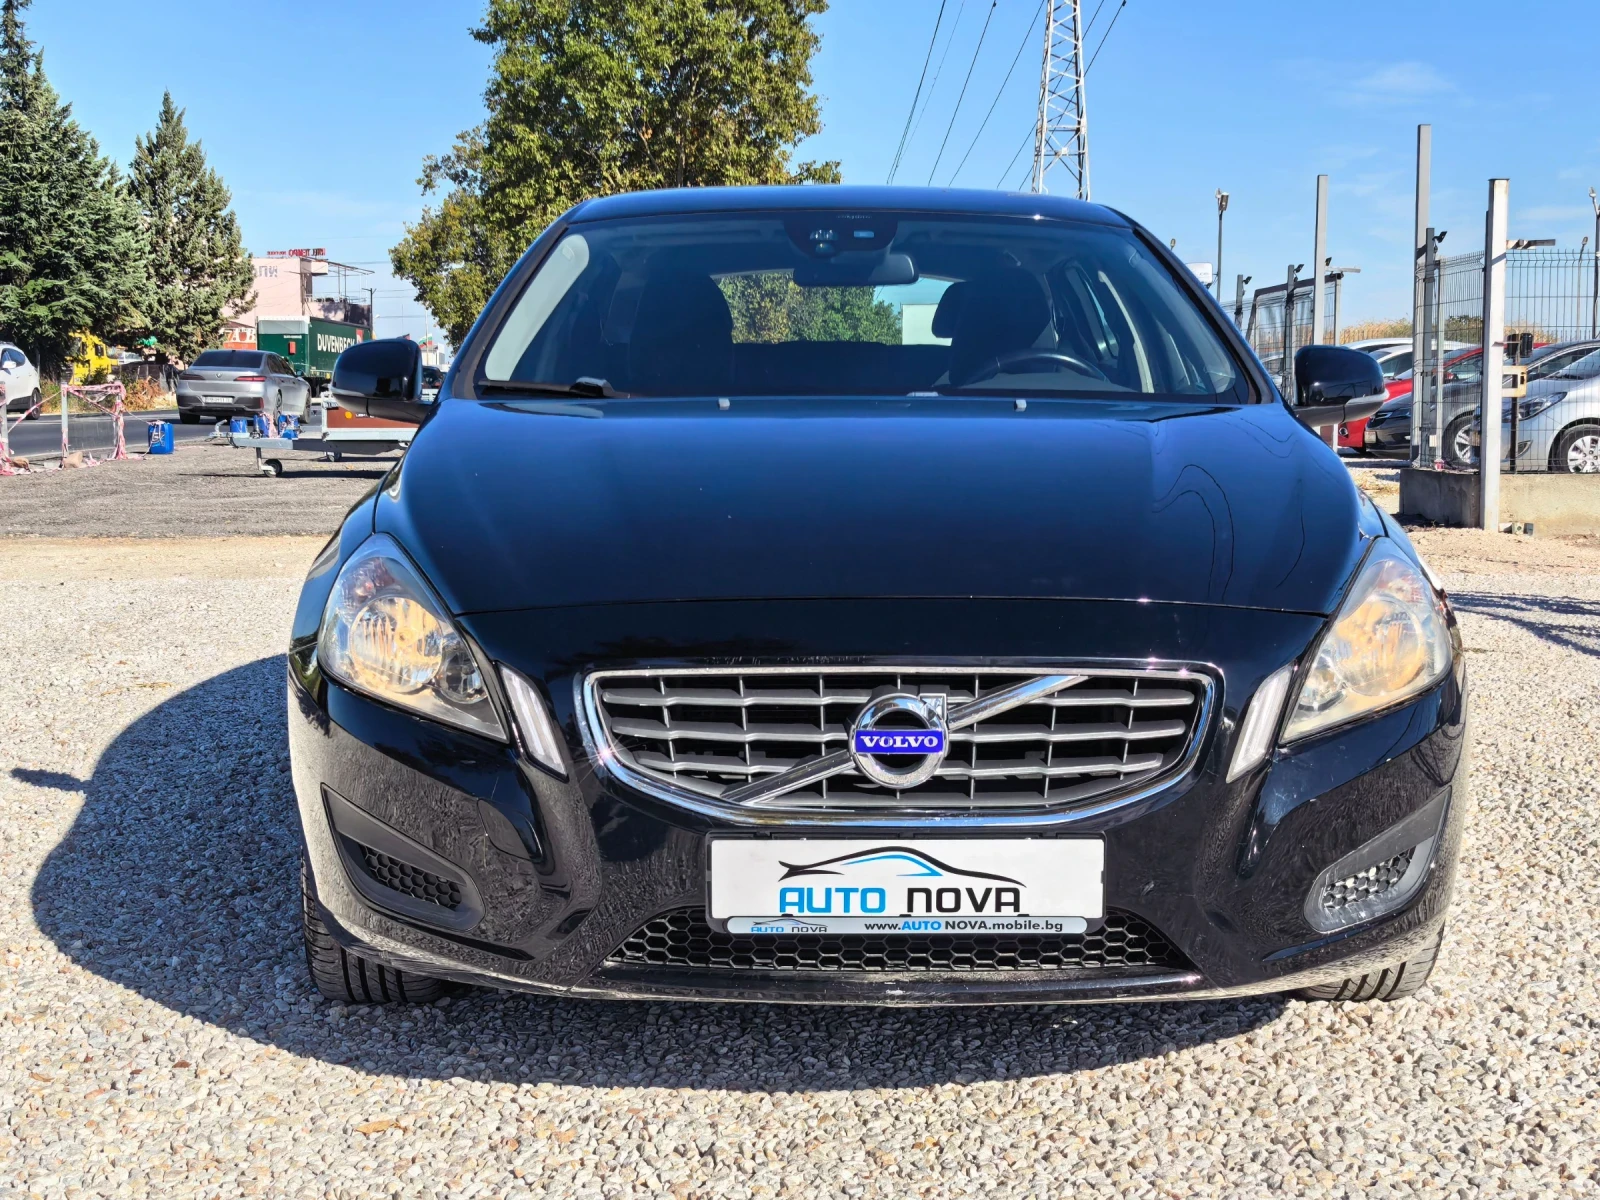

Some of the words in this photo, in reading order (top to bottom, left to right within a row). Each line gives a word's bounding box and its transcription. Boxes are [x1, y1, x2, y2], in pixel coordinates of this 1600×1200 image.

[860, 735, 939, 748] VOLVO
[779, 887, 886, 913] AUTO
[907, 887, 1020, 913] NOVA
[864, 920, 942, 931] www.AUTO
[945, 920, 1063, 932] NOVA.mobile.bg
